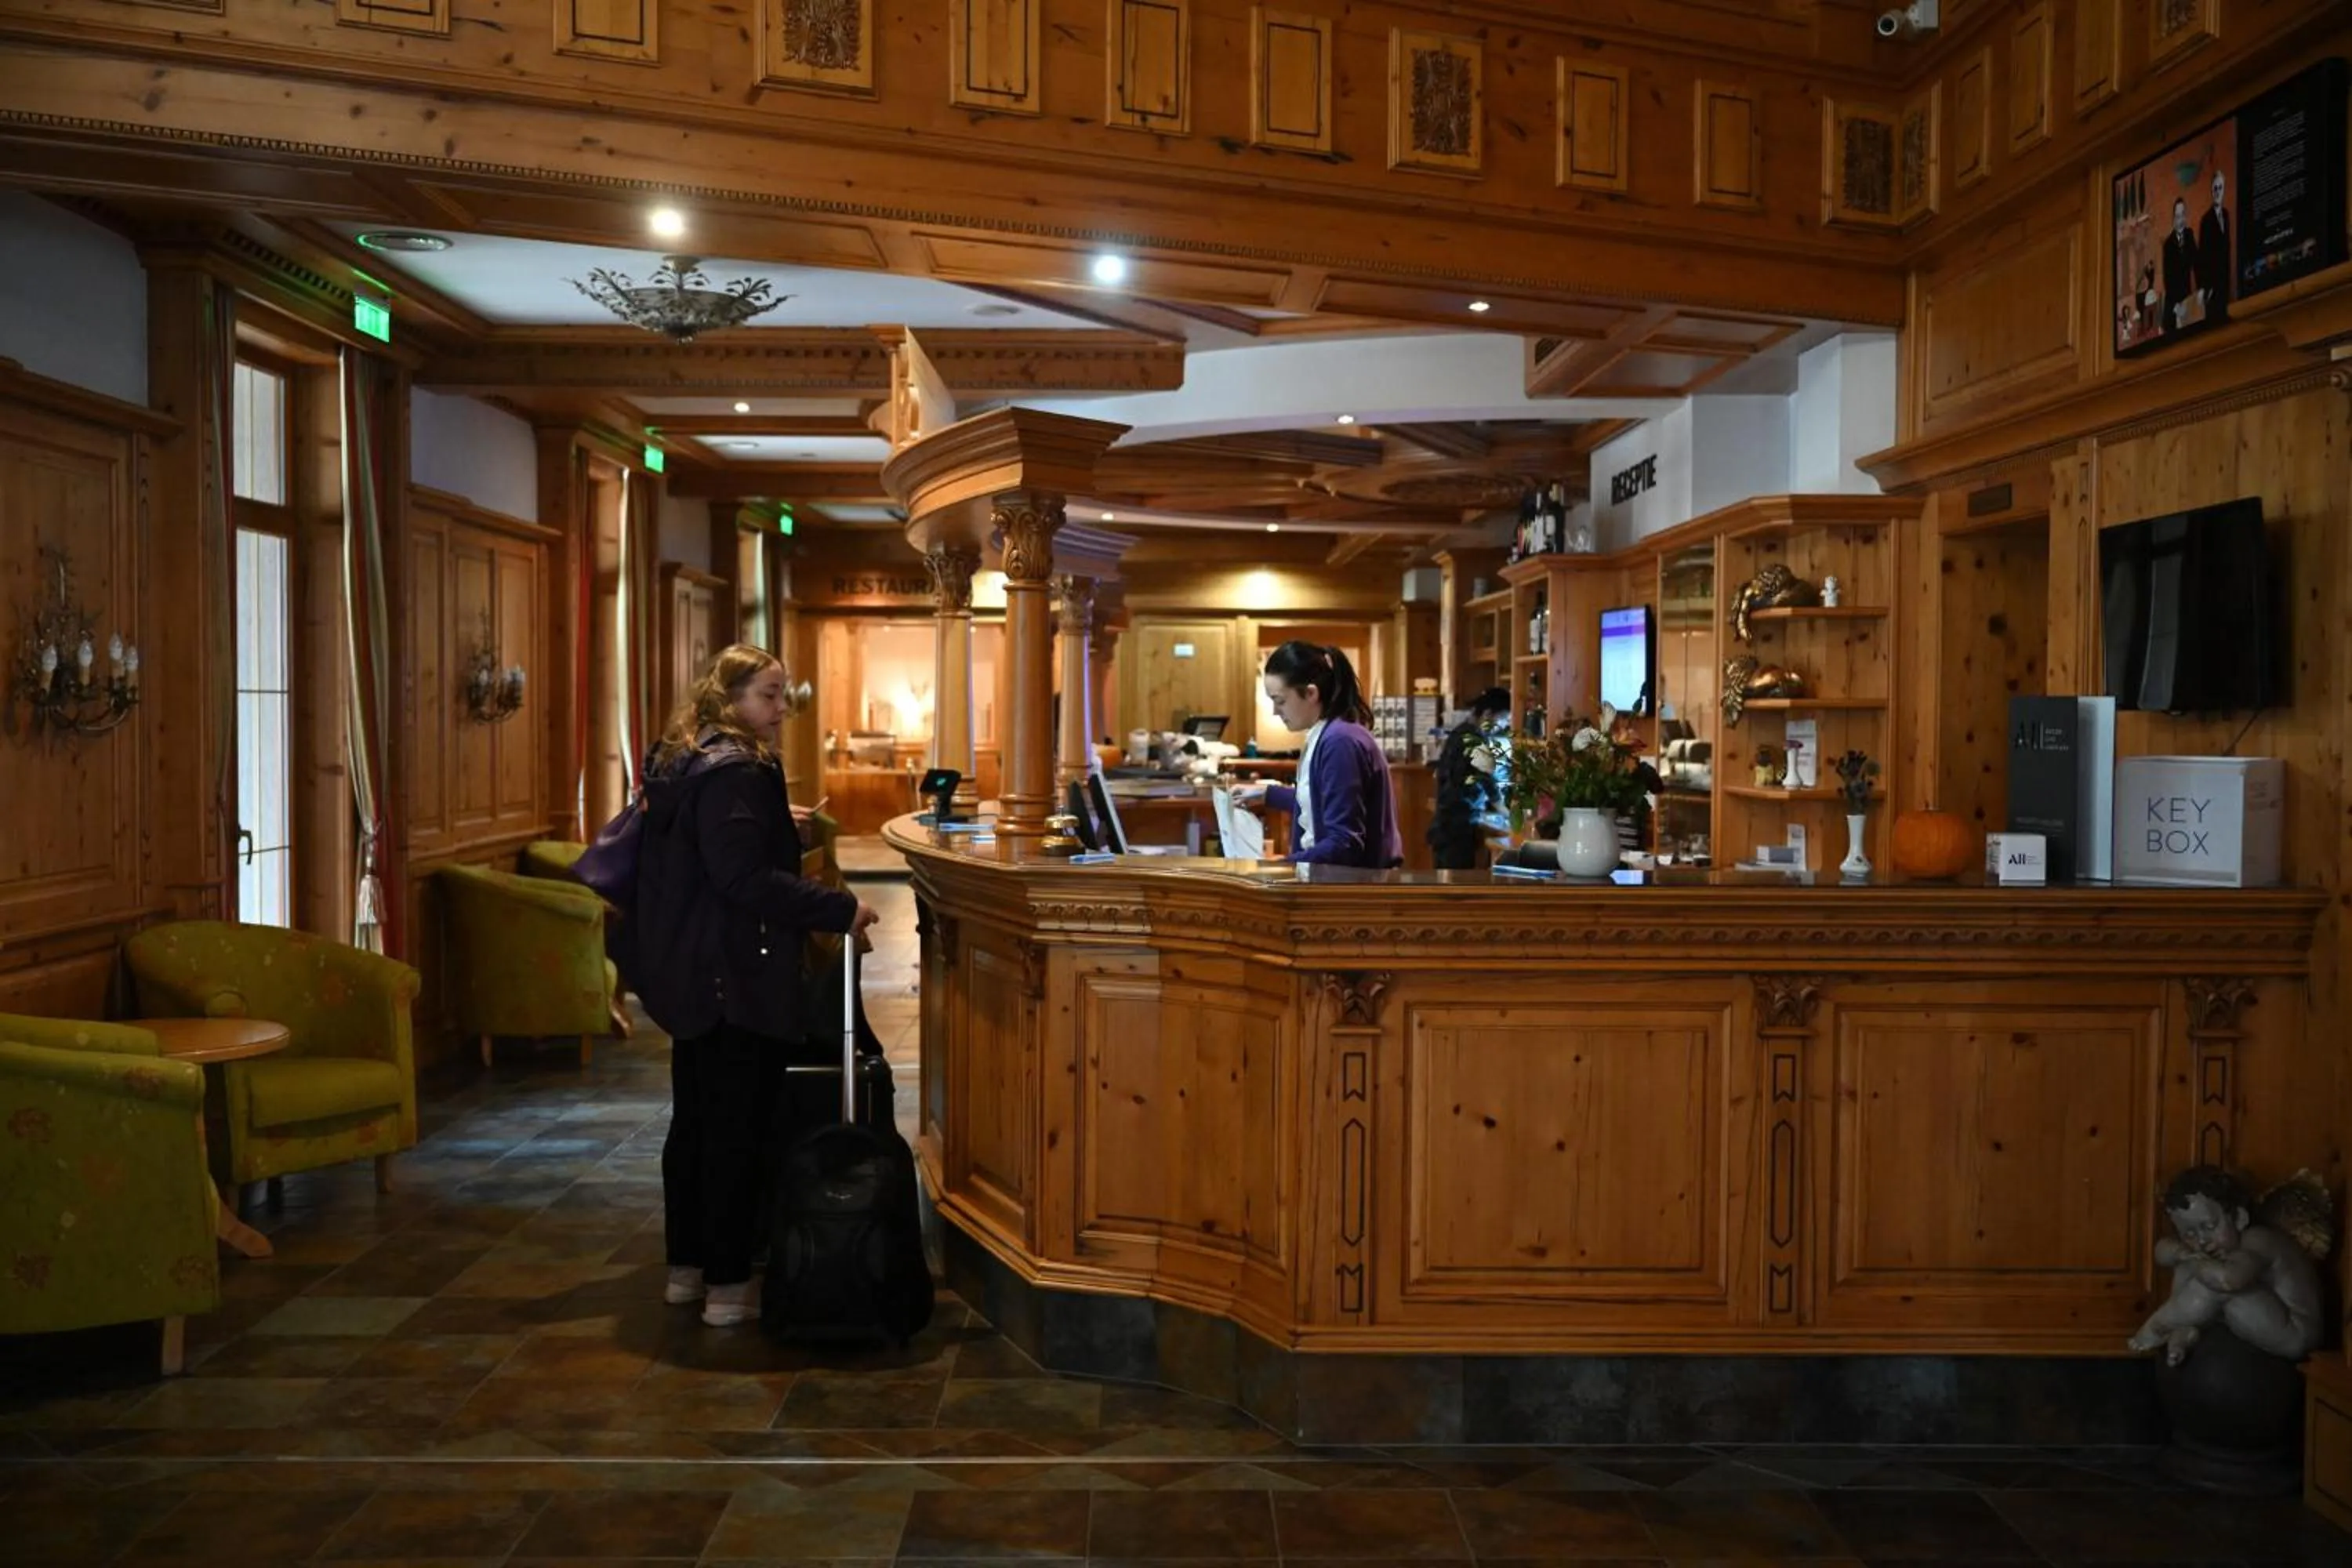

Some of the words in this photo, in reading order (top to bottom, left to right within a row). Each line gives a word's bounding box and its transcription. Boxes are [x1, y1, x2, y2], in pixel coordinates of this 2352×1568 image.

[833, 577, 934, 594] RESTAUR
[2146, 797, 2211, 823] KEY
[2146, 829, 2209, 855] BOX
